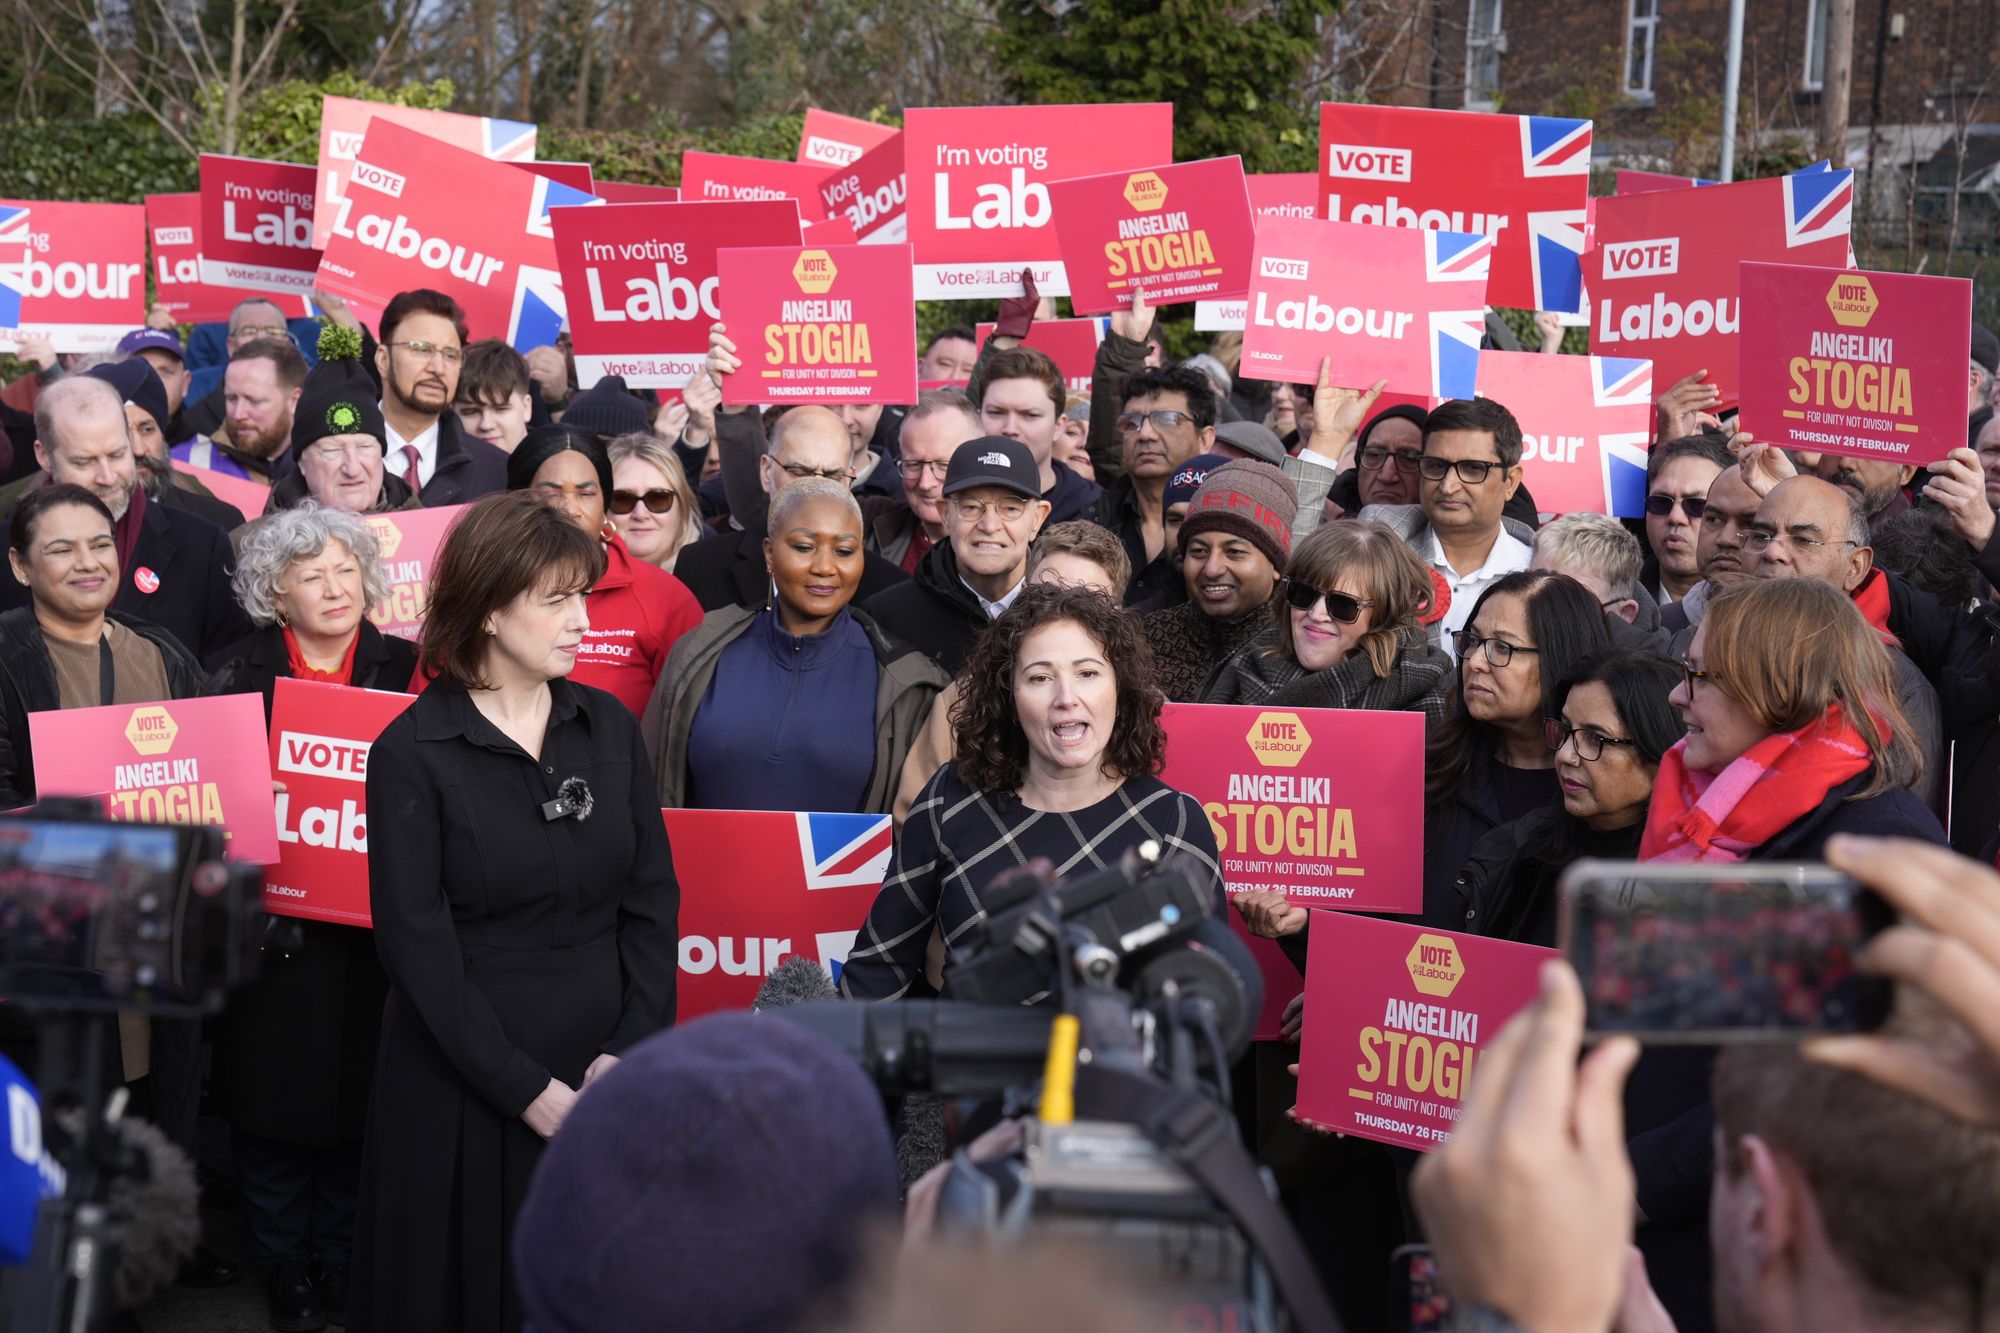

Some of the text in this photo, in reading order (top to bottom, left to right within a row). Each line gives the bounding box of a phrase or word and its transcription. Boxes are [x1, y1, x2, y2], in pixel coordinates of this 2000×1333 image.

[813, 142, 857, 162] VOTE
[936, 143, 1048, 171] I'm voting
[1336, 151, 1404, 175] VOTE
[357, 166, 400, 192] VOTE
[703, 180, 729, 198] I'm
[822, 175, 860, 208] Vote
[1132, 179, 1157, 193] VOTE
[225, 182, 314, 210] I'm voting
[827, 173, 907, 232] abou
[935, 168, 1052, 229] Lab
[158, 231, 190, 241] VOTE
[224, 201, 314, 249] Lab
[1118, 211, 1189, 239] ANGELIKI
[332, 197, 505, 288] Labour
[583, 239, 689, 265] I'm voting
[1104, 229, 1215, 277] STOGIA
[802, 259, 827, 272] VOTE
[1264, 260, 1306, 276] VOTE
[1609, 245, 1672, 272] VOTE
[24, 248, 141, 299] bour
[225, 267, 255, 280] Vote
[936, 269, 1051, 285] Vote Labur
[1141, 274, 1161, 286] UNITY
[1161, 273, 1176, 283] NOT
[586, 262, 721, 322] Labo
[1116, 290, 1161, 303] THUDAY
[1174, 283, 1219, 296] FEBRUARY
[1838, 284, 1867, 302] VOTE
[782, 300, 852, 322] ANGELIKI
[1254, 291, 1413, 339] Labour
[1599, 292, 1740, 343] Labou
[1840, 302, 1872, 313] Labour
[765, 323, 872, 365] STOGIA
[1810, 331, 1893, 364] ANGELIKI
[602, 361, 637, 376] Vote
[782, 369, 796, 379] FOR
[796, 369, 815, 379] UNITY
[816, 369, 829, 379] NOT
[768, 386, 815, 396] THURSDAY
[826, 386, 872, 396] FEBRUARY
[1788, 356, 1913, 416] STOGIA
[1807, 411, 1821, 423] FOR
[1823, 413, 1844, 426] UNITY
[1846, 415, 1862, 428] NOT
[1522, 432, 1585, 463] our
[1789, 429, 1910, 454] THURSDAY 26 FEBRUARY
[591, 642, 634, 657] Labour
[136, 715, 166, 731] VOTE
[1261, 722, 1297, 740] VOTE
[287, 739, 367, 774] VOTE
[1264, 740, 1303, 752] Labour
[115, 758, 198, 790] ANGELIKI
[1227, 773, 1330, 805] ANGELIKI
[274, 793, 369, 853] Lab
[1202, 802, 1358, 859] STOGIA
[1225, 860, 1333, 876] FOR UNITY NOT DIVISON
[273, 884, 307, 898] Labour
[1289, 885, 1355, 899] FEBRUARY
[677, 935, 791, 976] our
[1420, 945, 1452, 968] VOTE
[1421, 966, 1456, 982] Labour
[1384, 997, 1479, 1044] ANGELIKI
[1357, 1026, 1486, 1101] STOGI
[1375, 1091, 1463, 1122] FOR UNITY NOT DIVIS
[1354, 1111, 1415, 1136] THURSDAY
[1415, 1125, 1430, 1139] 26
